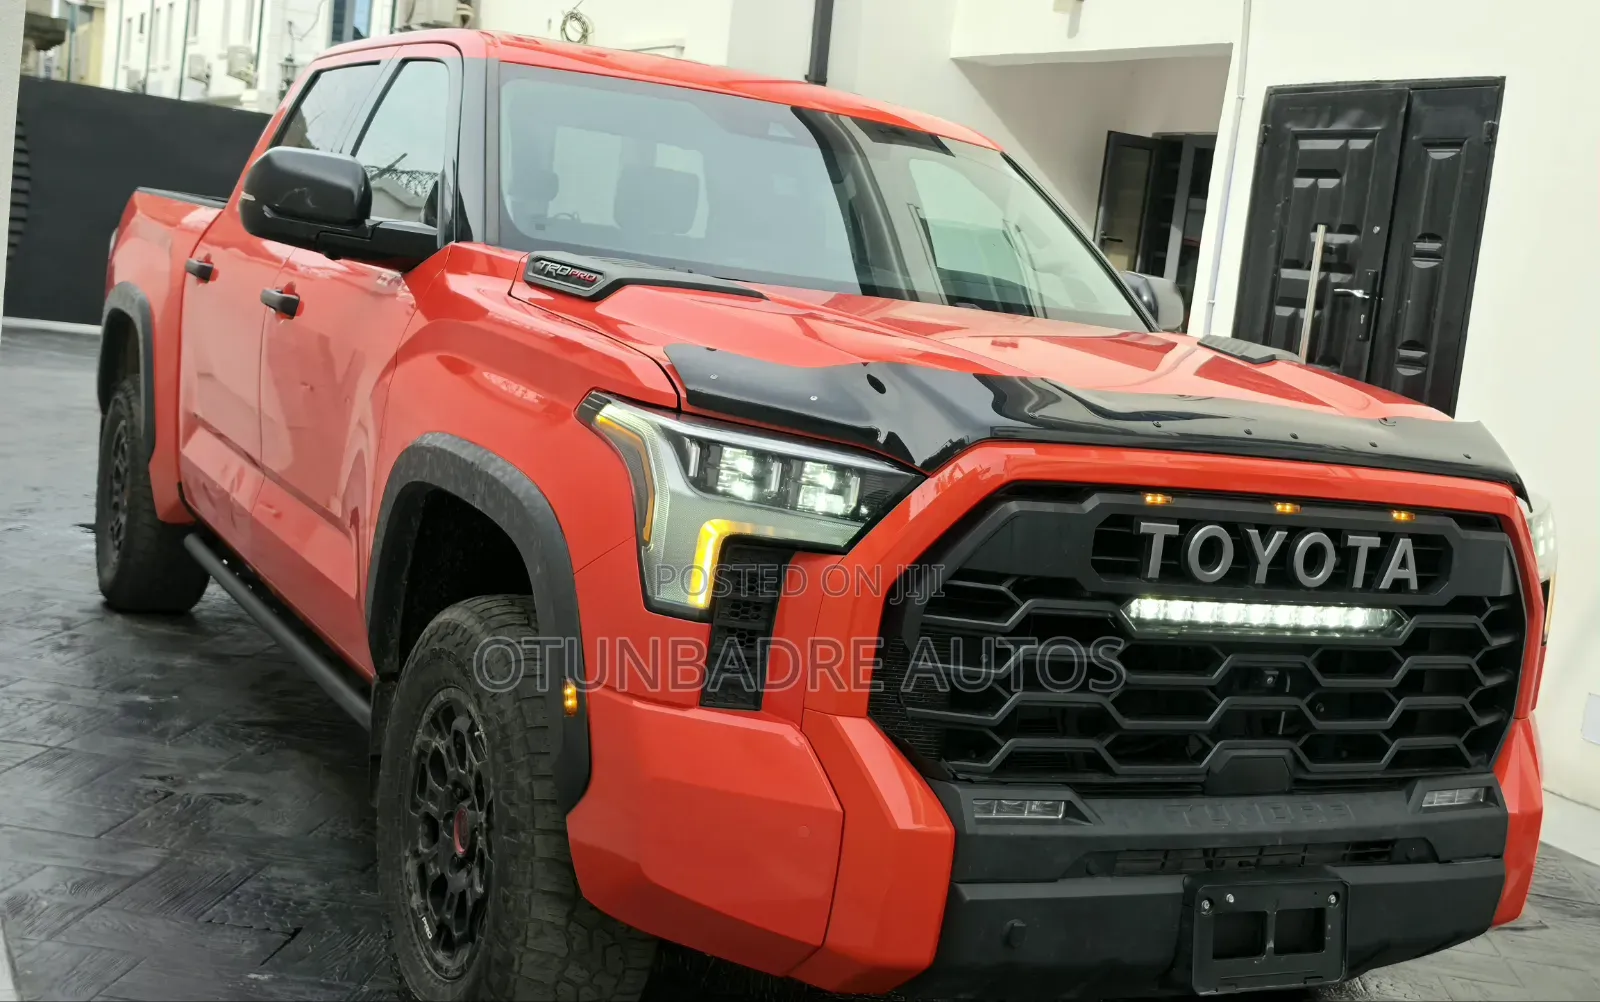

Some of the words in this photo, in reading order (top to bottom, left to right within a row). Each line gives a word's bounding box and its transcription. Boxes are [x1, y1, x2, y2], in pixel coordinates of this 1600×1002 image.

[540, 260, 572, 277] TRD
[568, 268, 598, 283] PRO
[1139, 521, 1419, 591] TOYOTA
